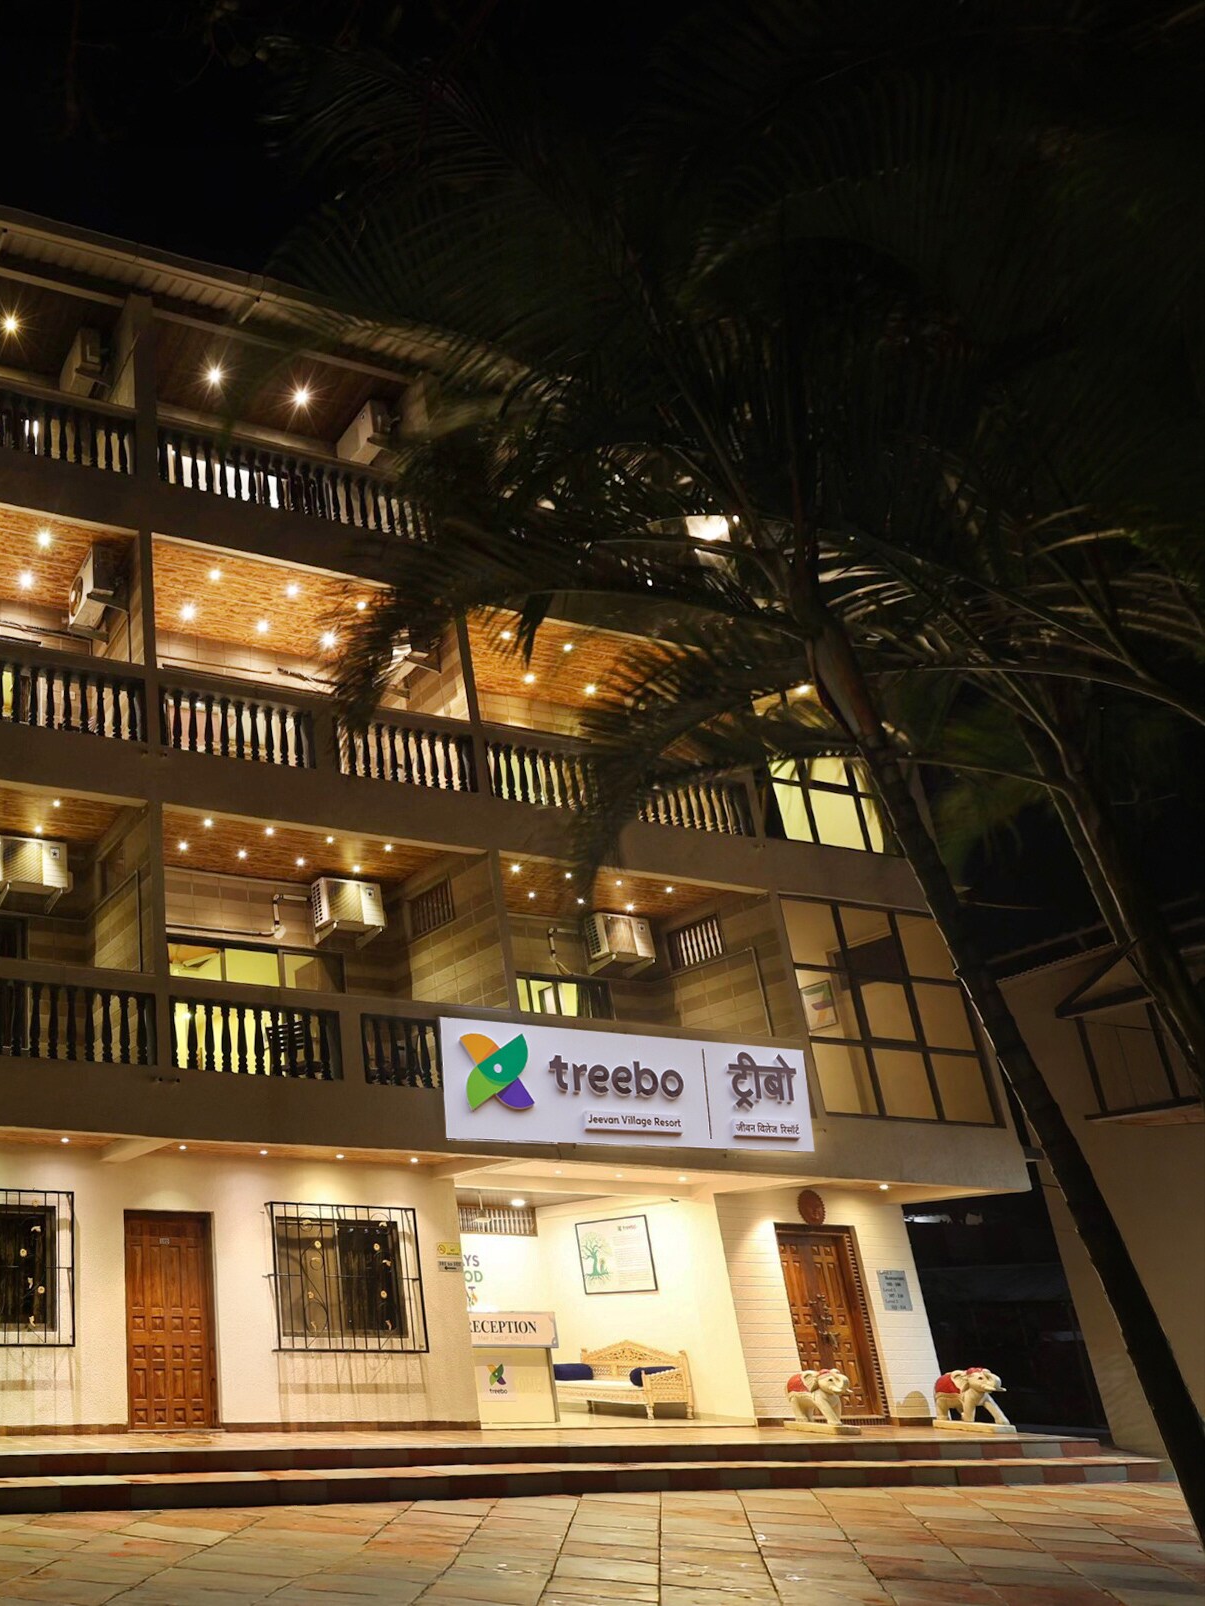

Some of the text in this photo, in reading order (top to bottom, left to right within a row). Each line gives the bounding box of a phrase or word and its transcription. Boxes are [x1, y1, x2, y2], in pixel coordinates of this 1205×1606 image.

[548, 1055, 684, 1098] treebo
[727, 1052, 796, 1109] ट्रीबो
[588, 1114, 681, 1128] Jeevan Village Resort
[470, 1320, 537, 1334] ECEPTION
